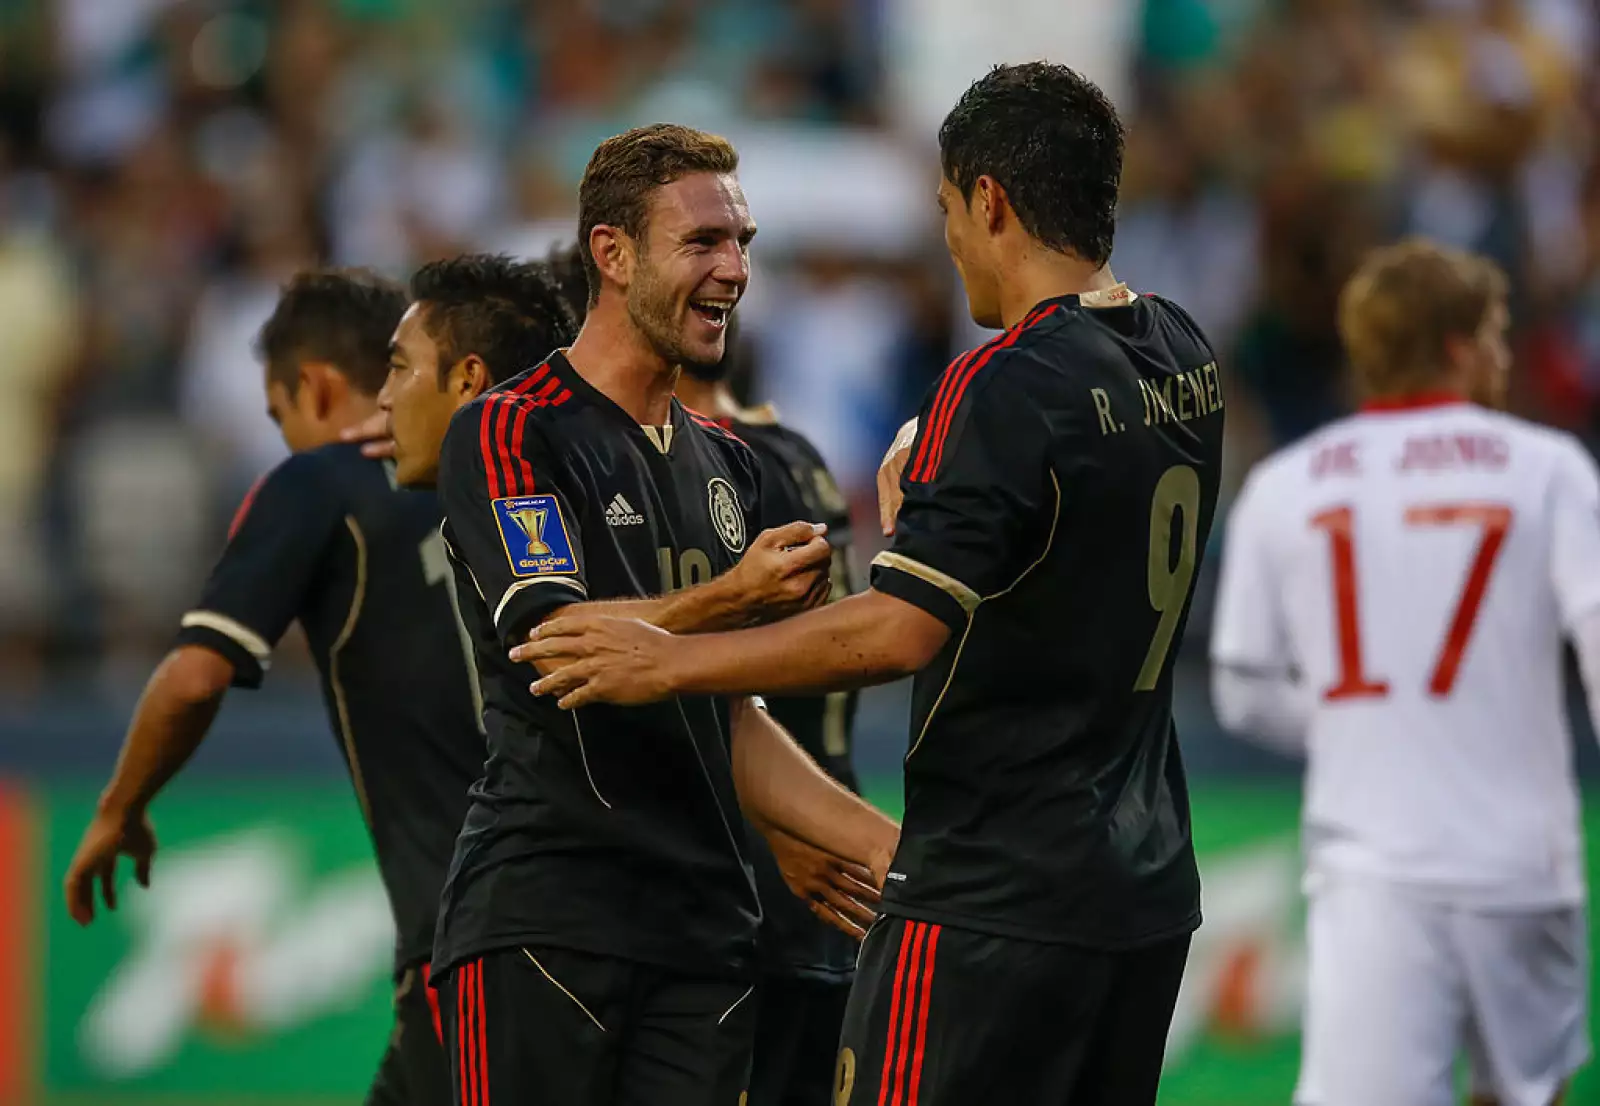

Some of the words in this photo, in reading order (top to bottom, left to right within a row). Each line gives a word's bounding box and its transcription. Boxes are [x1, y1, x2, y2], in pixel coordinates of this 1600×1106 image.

[1090, 386, 1126, 436] R.
[1133, 464, 1200, 692] 9
[1308, 504, 1514, 702] 17
